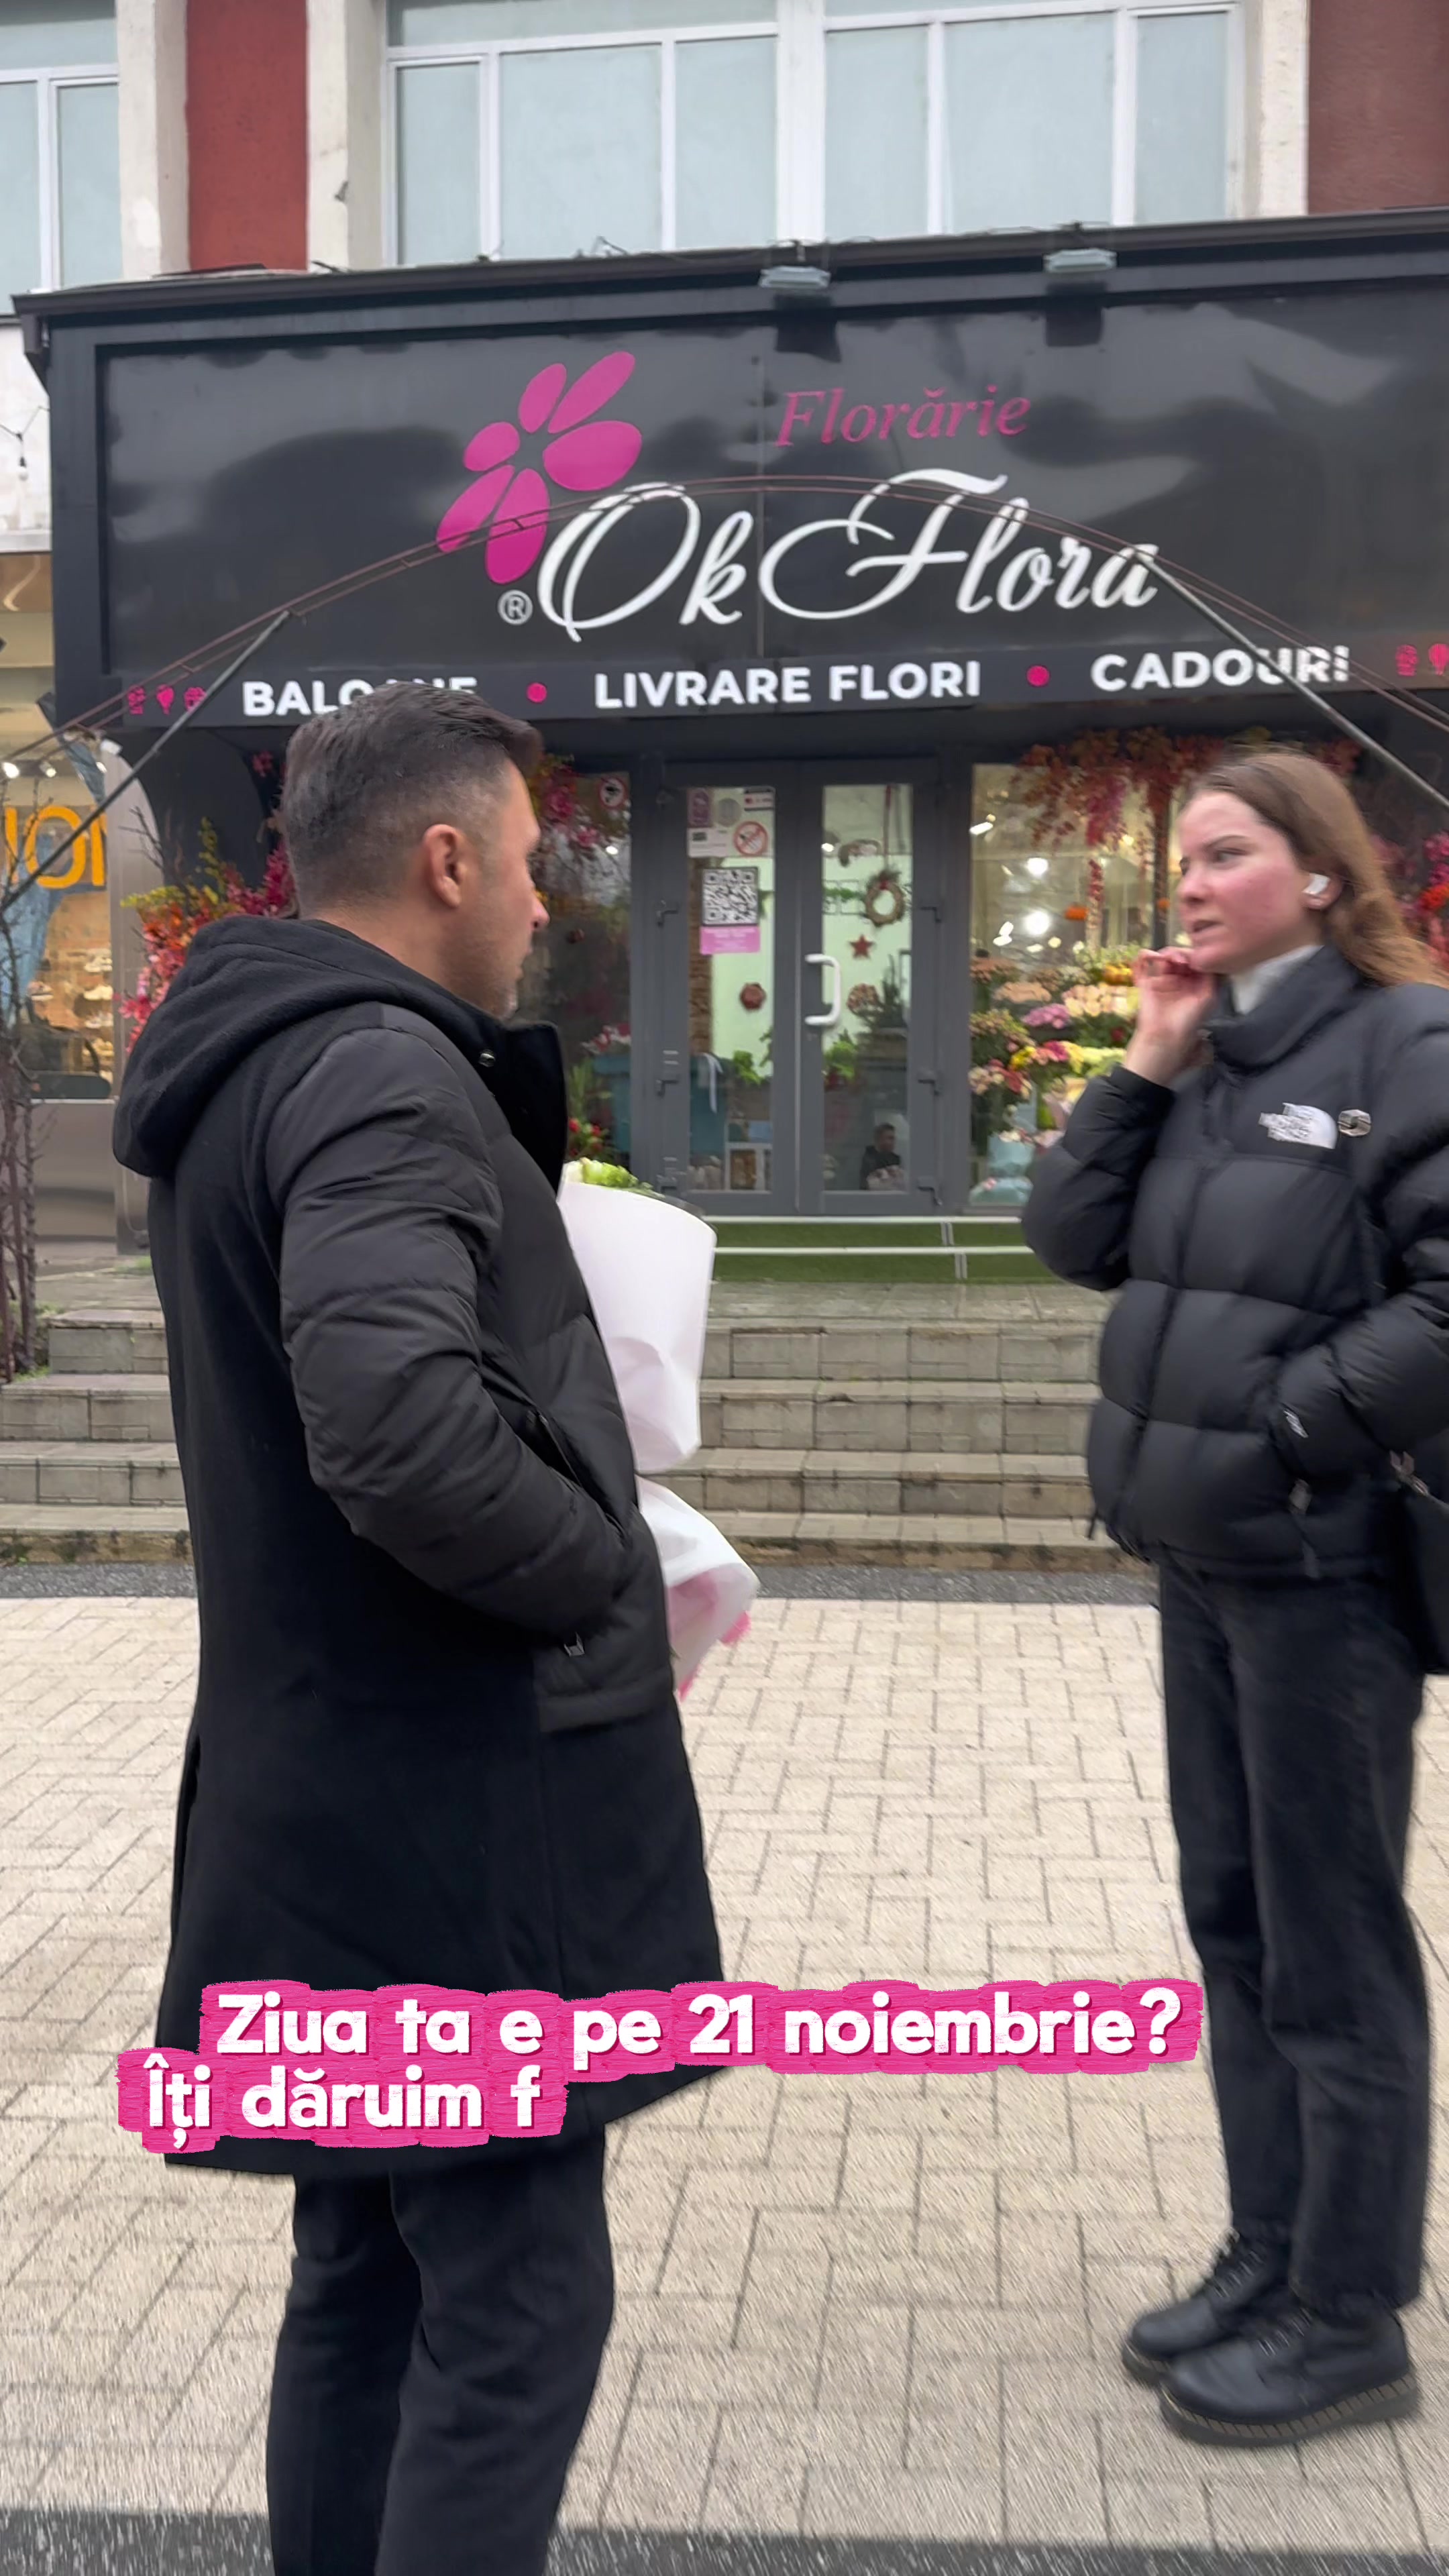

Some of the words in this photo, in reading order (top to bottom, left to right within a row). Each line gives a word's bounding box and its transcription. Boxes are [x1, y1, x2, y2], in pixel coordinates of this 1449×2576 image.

[775, 385, 1030, 447] Florărie
[595, 667, 810, 708] LIVRARE
[829, 661, 980, 701] FLORI
[1090, 645, 1349, 692] CADOURI
